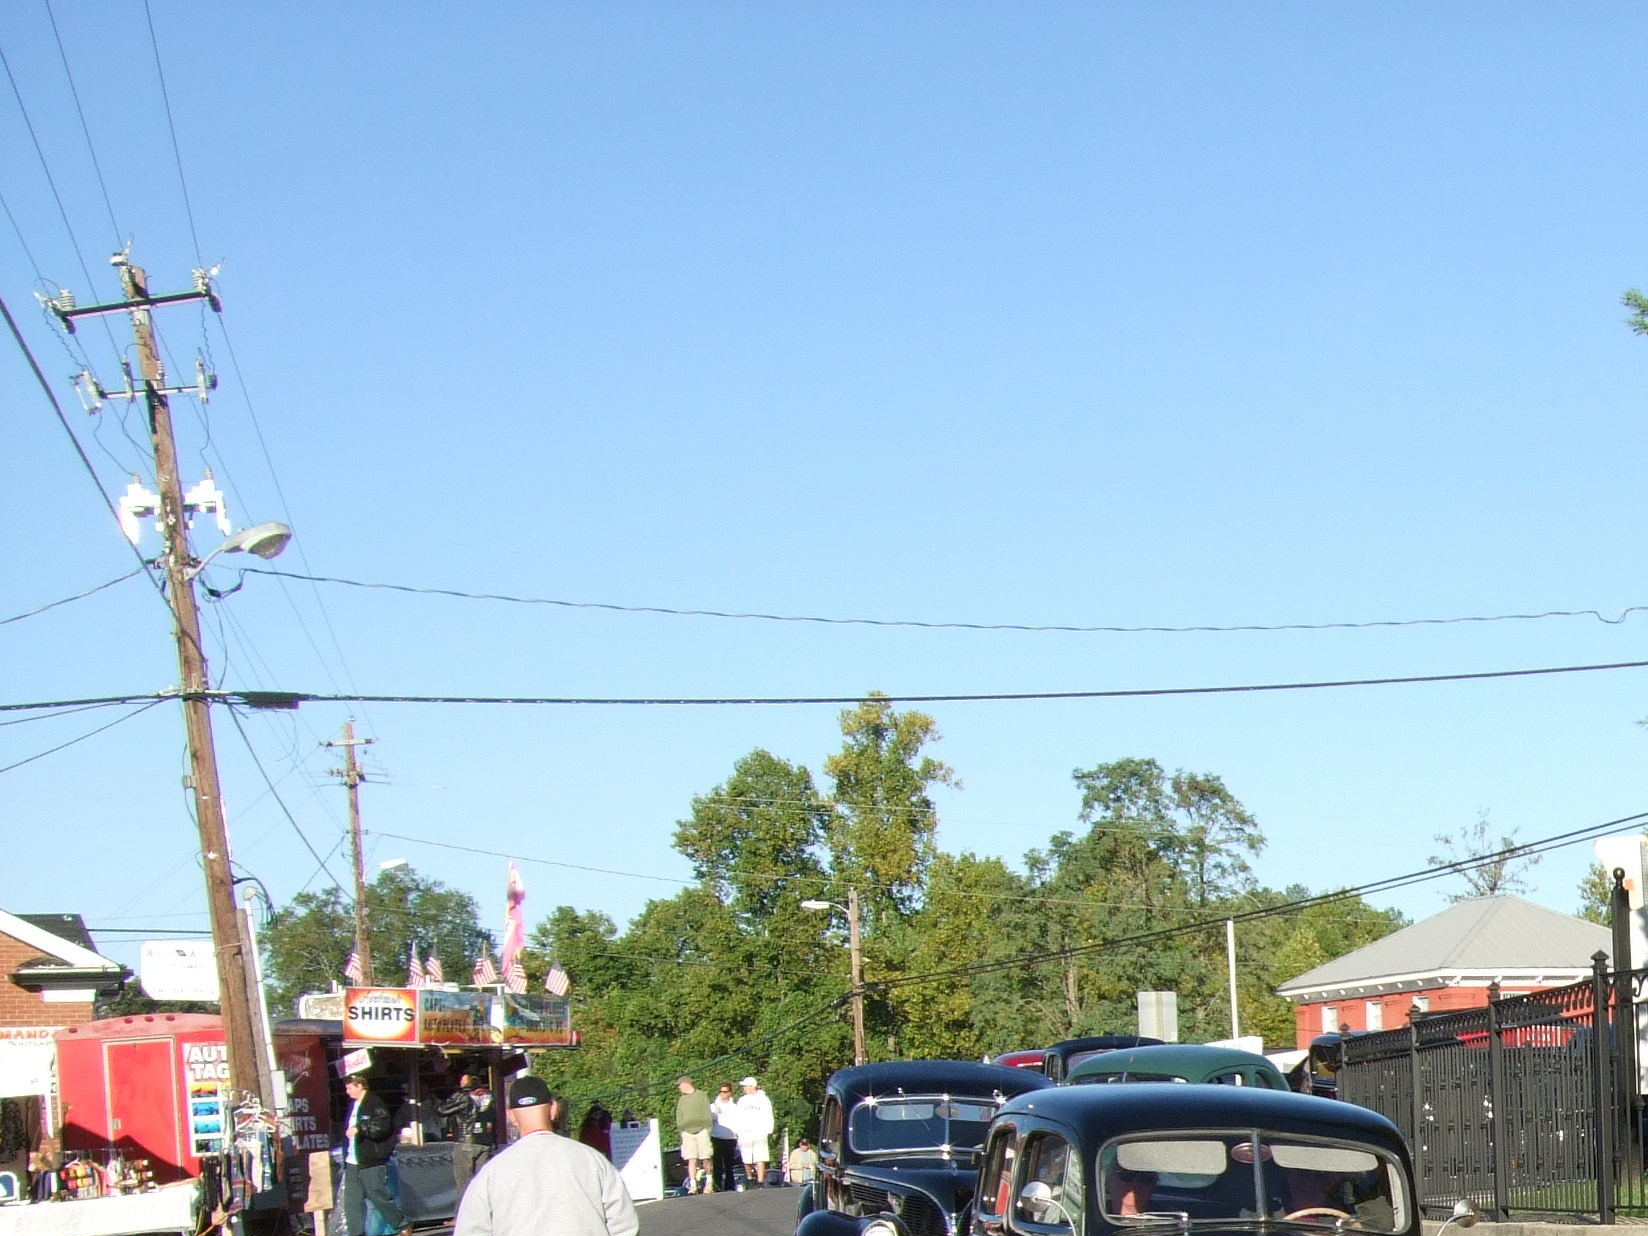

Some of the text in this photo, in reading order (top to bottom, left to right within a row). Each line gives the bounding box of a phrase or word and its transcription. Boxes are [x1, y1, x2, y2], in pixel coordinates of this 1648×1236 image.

[347, 1005, 415, 1022] SHIRTS
[188, 1044, 228, 1063] AUT
[191, 1062, 231, 1080] TAG
[288, 1098, 309, 1113] APS
[292, 1116, 317, 1131] IRTS
